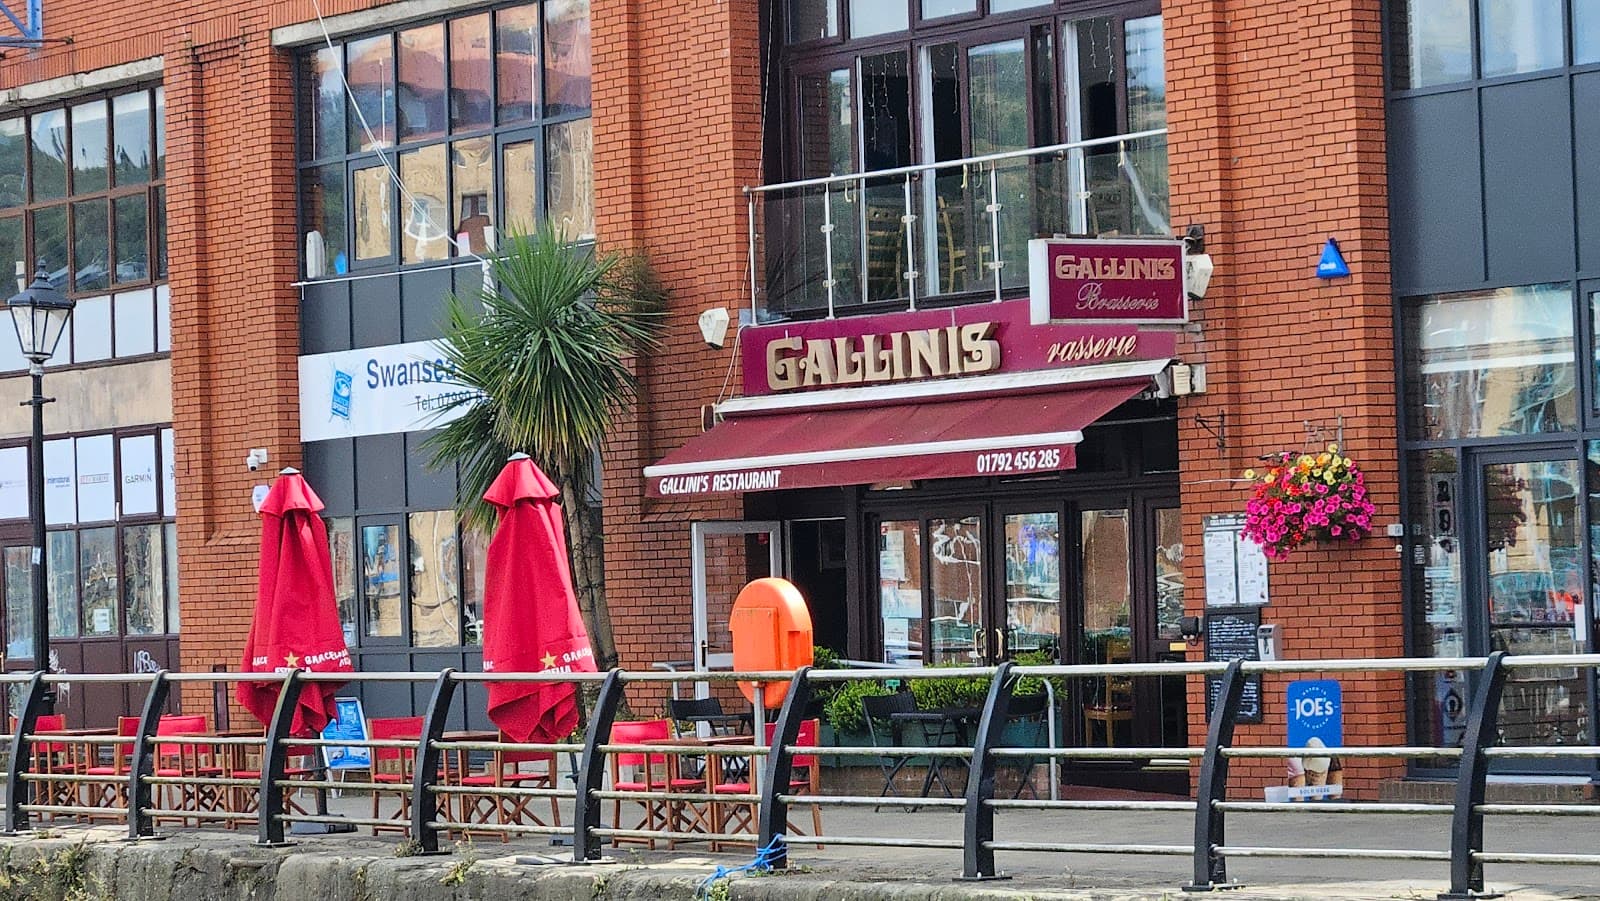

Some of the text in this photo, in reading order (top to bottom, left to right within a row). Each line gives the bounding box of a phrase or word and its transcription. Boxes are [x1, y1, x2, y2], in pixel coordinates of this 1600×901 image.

[1075, 282, 1160, 310] Brasserie
[977, 448, 1060, 473] 01792 456 285
[125, 473, 152, 484] GARMIN
[659, 470, 782, 495] GALLINI'S RESTAURANT
[1295, 697, 1334, 720] JOE'S
